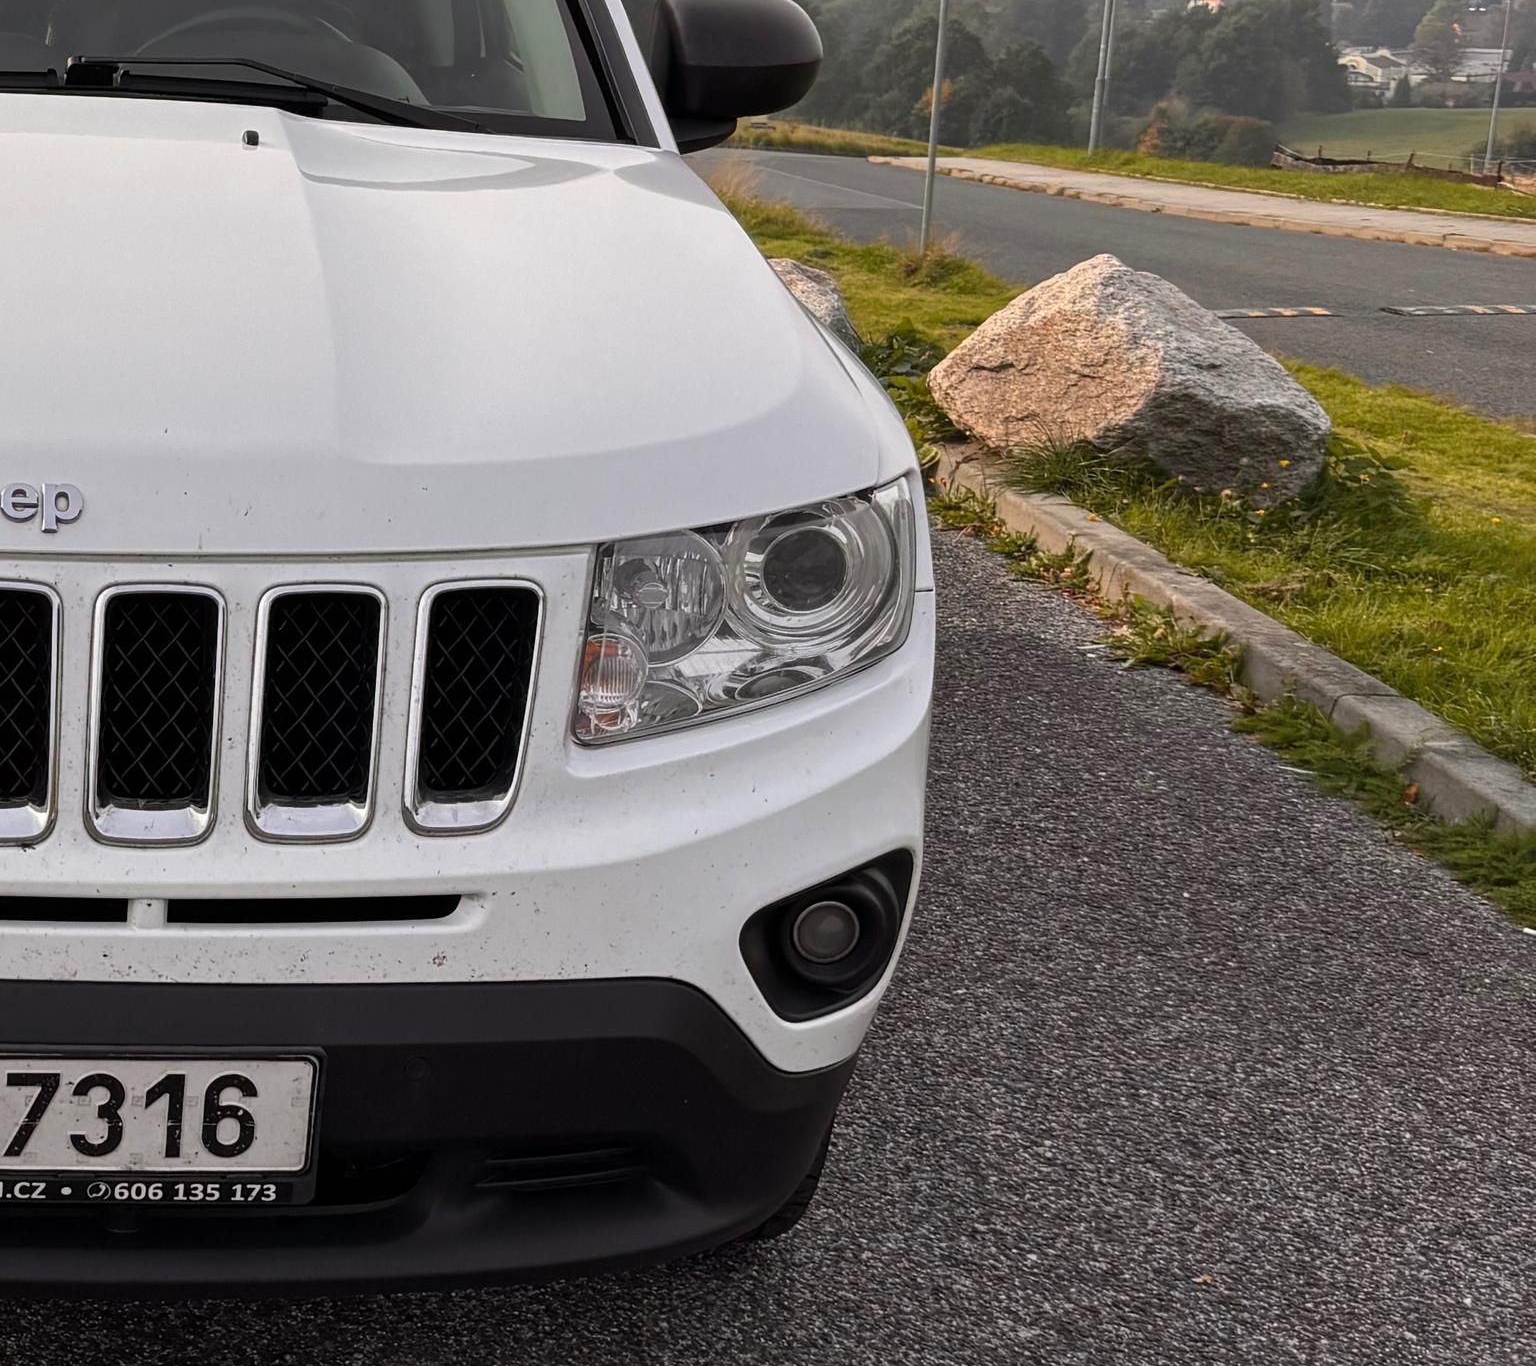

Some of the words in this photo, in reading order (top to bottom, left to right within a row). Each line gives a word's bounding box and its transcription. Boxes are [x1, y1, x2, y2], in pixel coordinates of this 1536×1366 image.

[2, 1071, 260, 1159] 7316
[113, 1181, 163, 1201] 606
[172, 1181, 221, 1202] 135
[230, 1182, 277, 1202] 173
